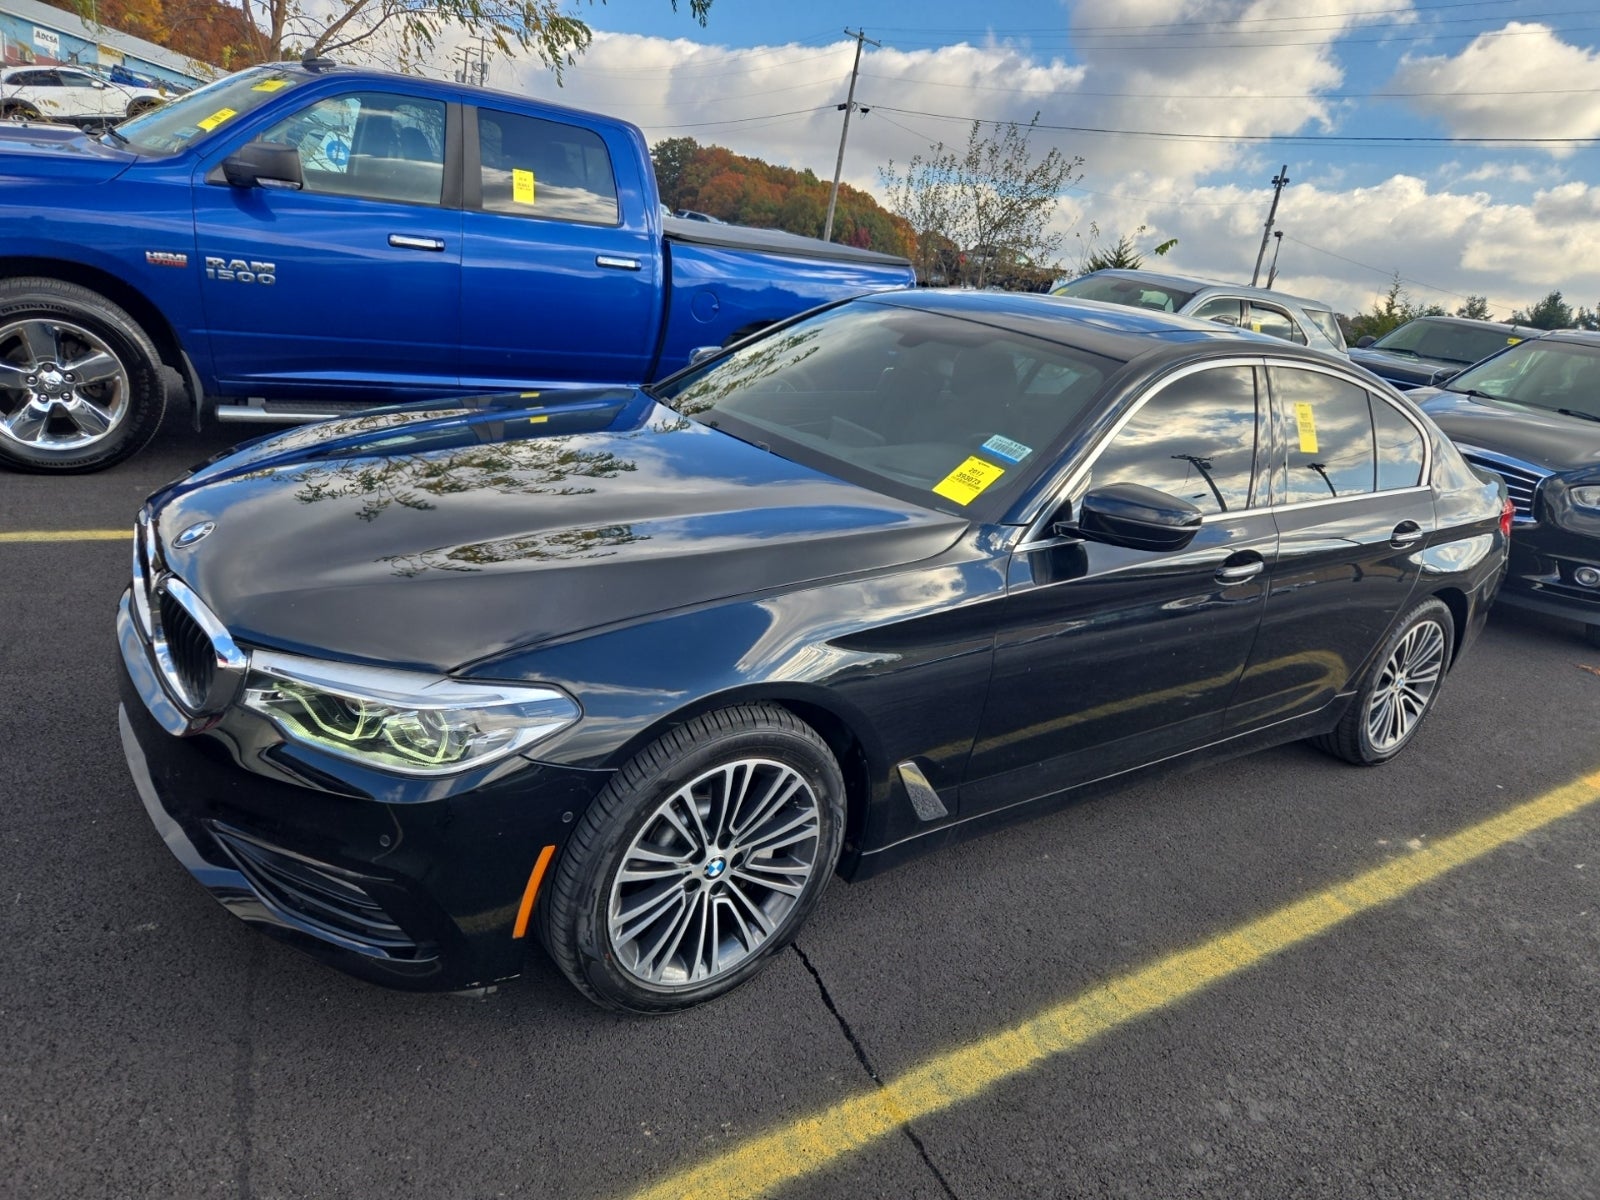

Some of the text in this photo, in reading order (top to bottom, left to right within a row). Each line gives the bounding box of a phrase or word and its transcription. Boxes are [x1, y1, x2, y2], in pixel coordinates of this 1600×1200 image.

[145, 251, 188, 262] HEMI
[205, 256, 276, 274] RAM
[206, 268, 276, 285] 1500
[1, 303, 70, 314] DESTINATION
[968, 467, 985, 477] 2017
